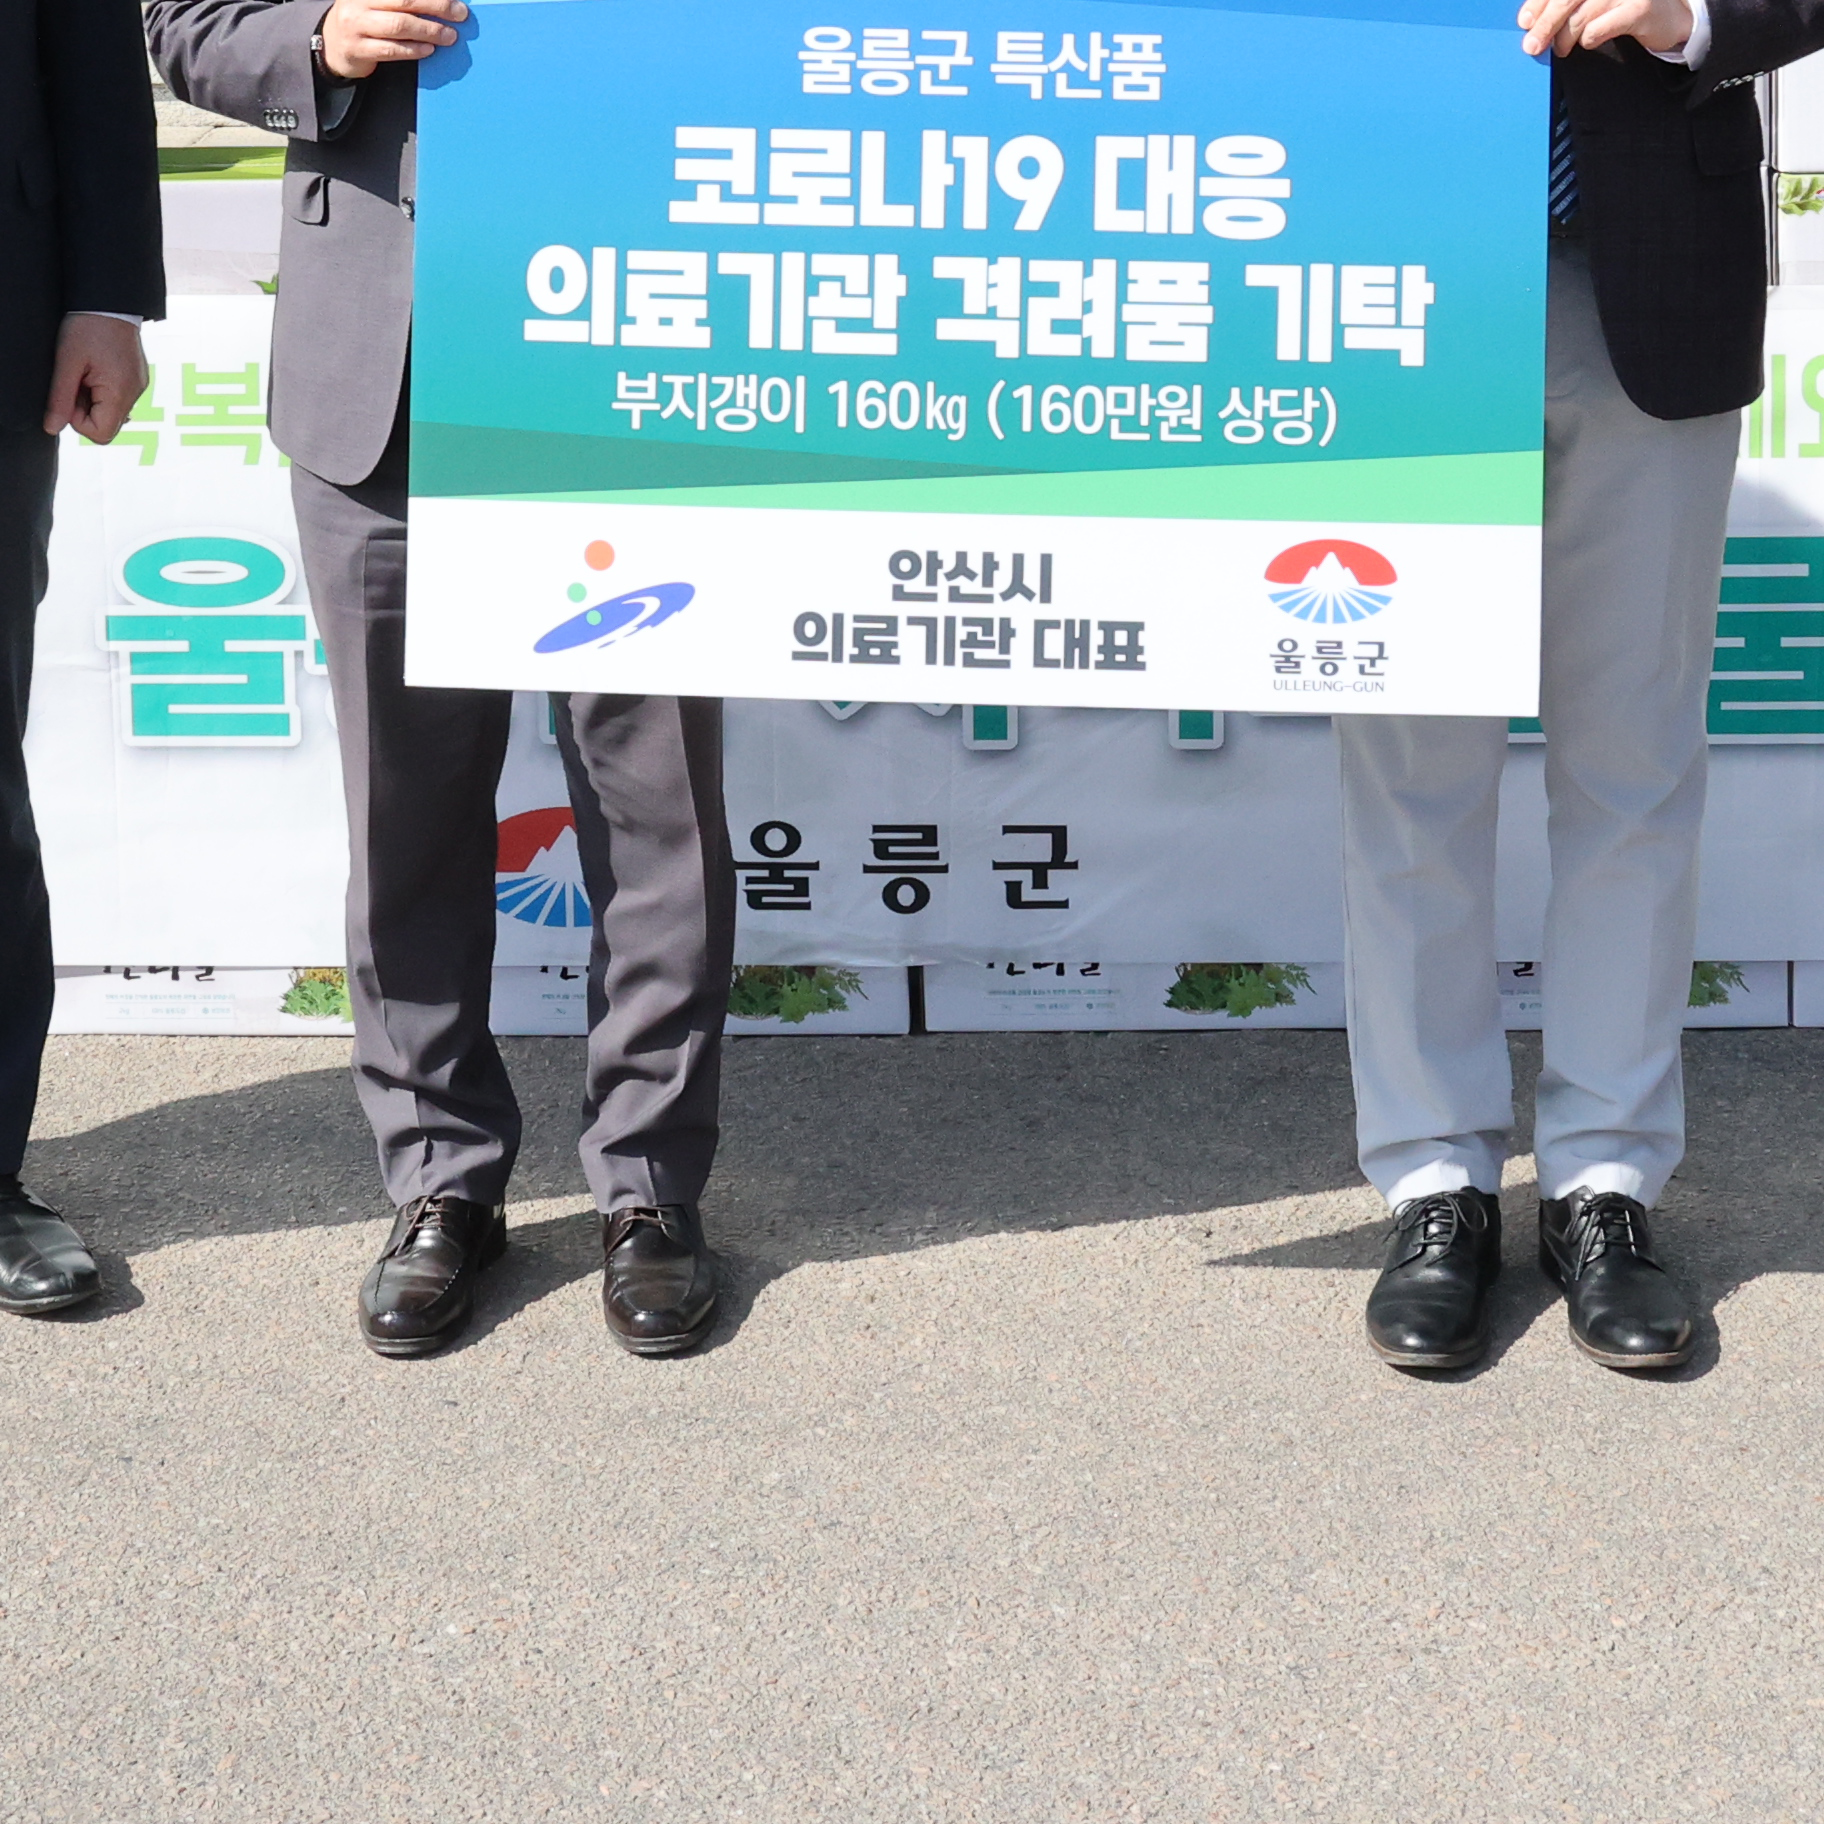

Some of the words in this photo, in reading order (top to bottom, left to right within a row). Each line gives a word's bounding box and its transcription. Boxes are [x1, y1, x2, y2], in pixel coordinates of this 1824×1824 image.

[799, 27, 972, 94] 울릉군
[991, 32, 1165, 99] 특산품
[670, 127, 1063, 230] 코로나19
[1095, 135, 1290, 239] 대응
[525, 246, 906, 354] 의료기관
[934, 257, 1212, 361] 격려품
[1246, 264, 1433, 365] 기탁
[613, 373, 804, 432] 부지갱이
[829, 381, 965, 440] 160kg
[989, 381, 1201, 441] (160만원
[1219, 387, 1335, 446] 상당)
[889, 550, 1052, 603] 안산시
[792, 612, 1015, 668] 의료기관
[1034, 619, 1145, 670] 대표
[1271, 639, 1387, 675] 울릉군
[1272, 678, 1385, 693] ULLEUNG-GUN
[727, 821, 1078, 918] 울릉군
